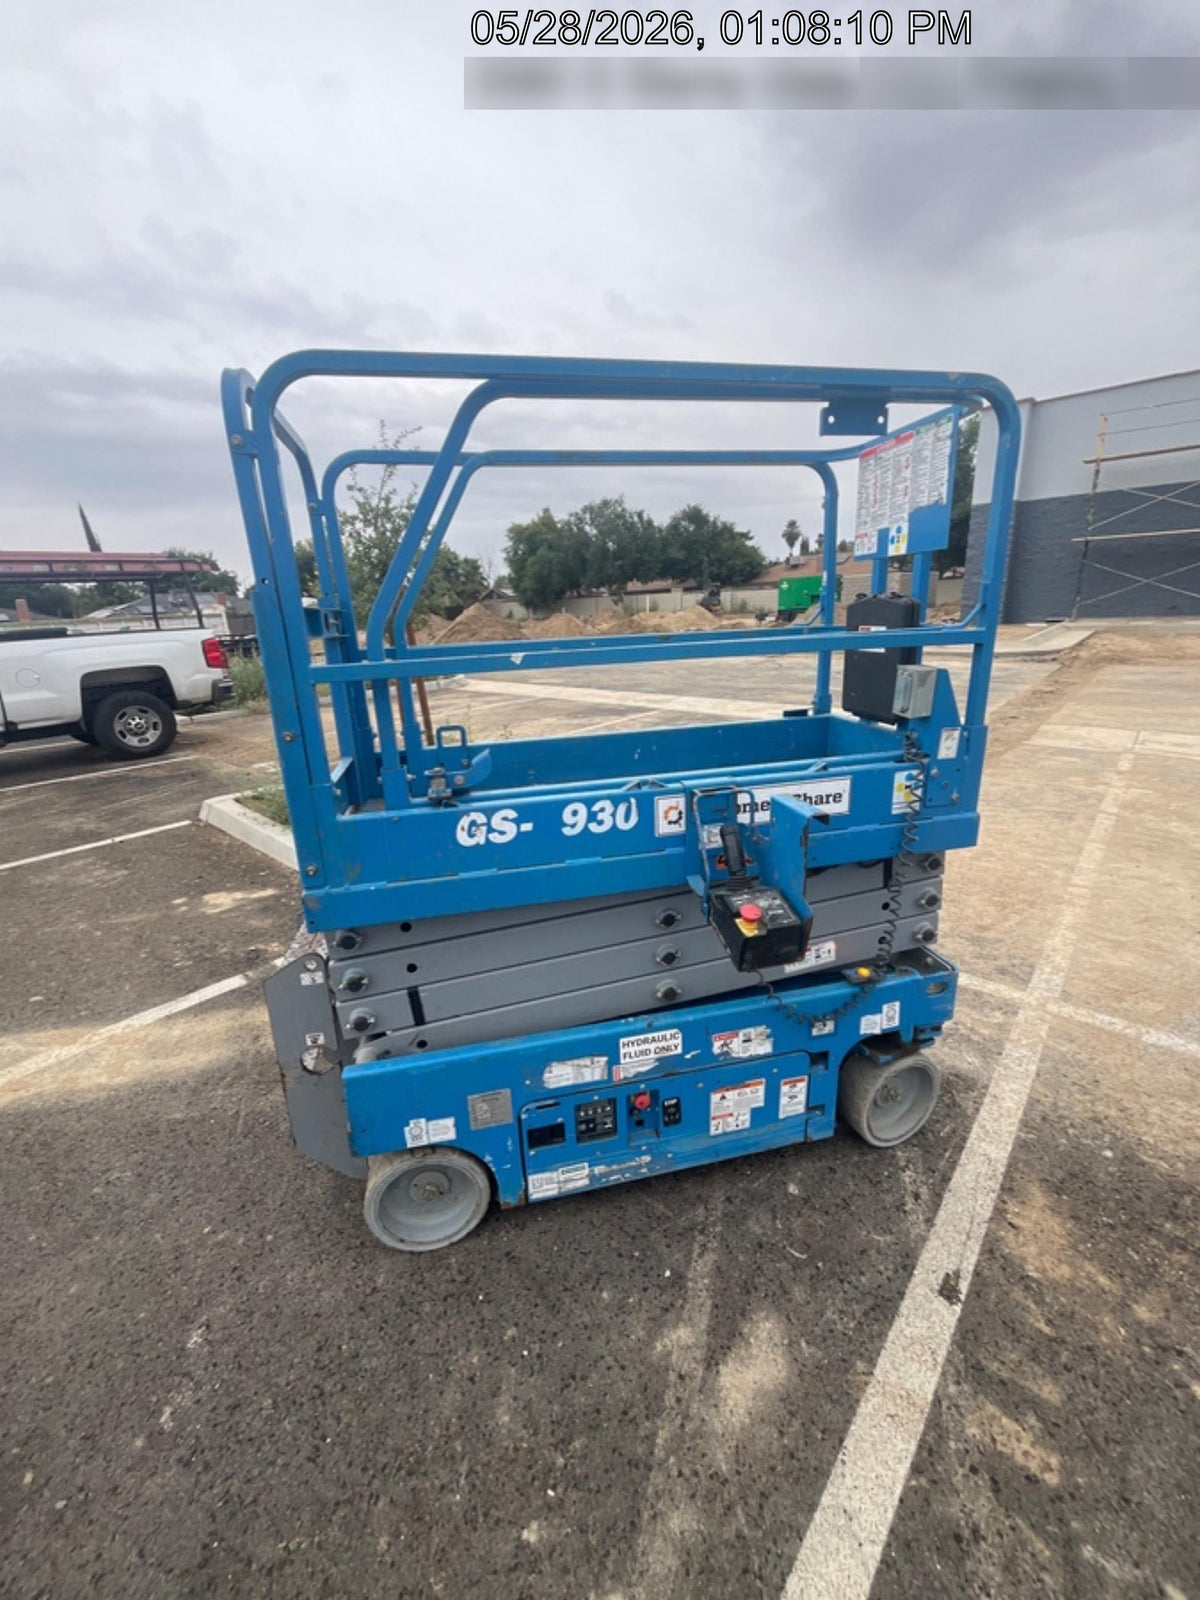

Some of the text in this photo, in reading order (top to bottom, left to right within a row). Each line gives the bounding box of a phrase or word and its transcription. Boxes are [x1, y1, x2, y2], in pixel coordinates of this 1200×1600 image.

[456, 797, 639, 847] GS- 930
[622, 1031, 680, 1049] HYDRAULIC
[623, 1042, 680, 1060] FLUID ONLY
